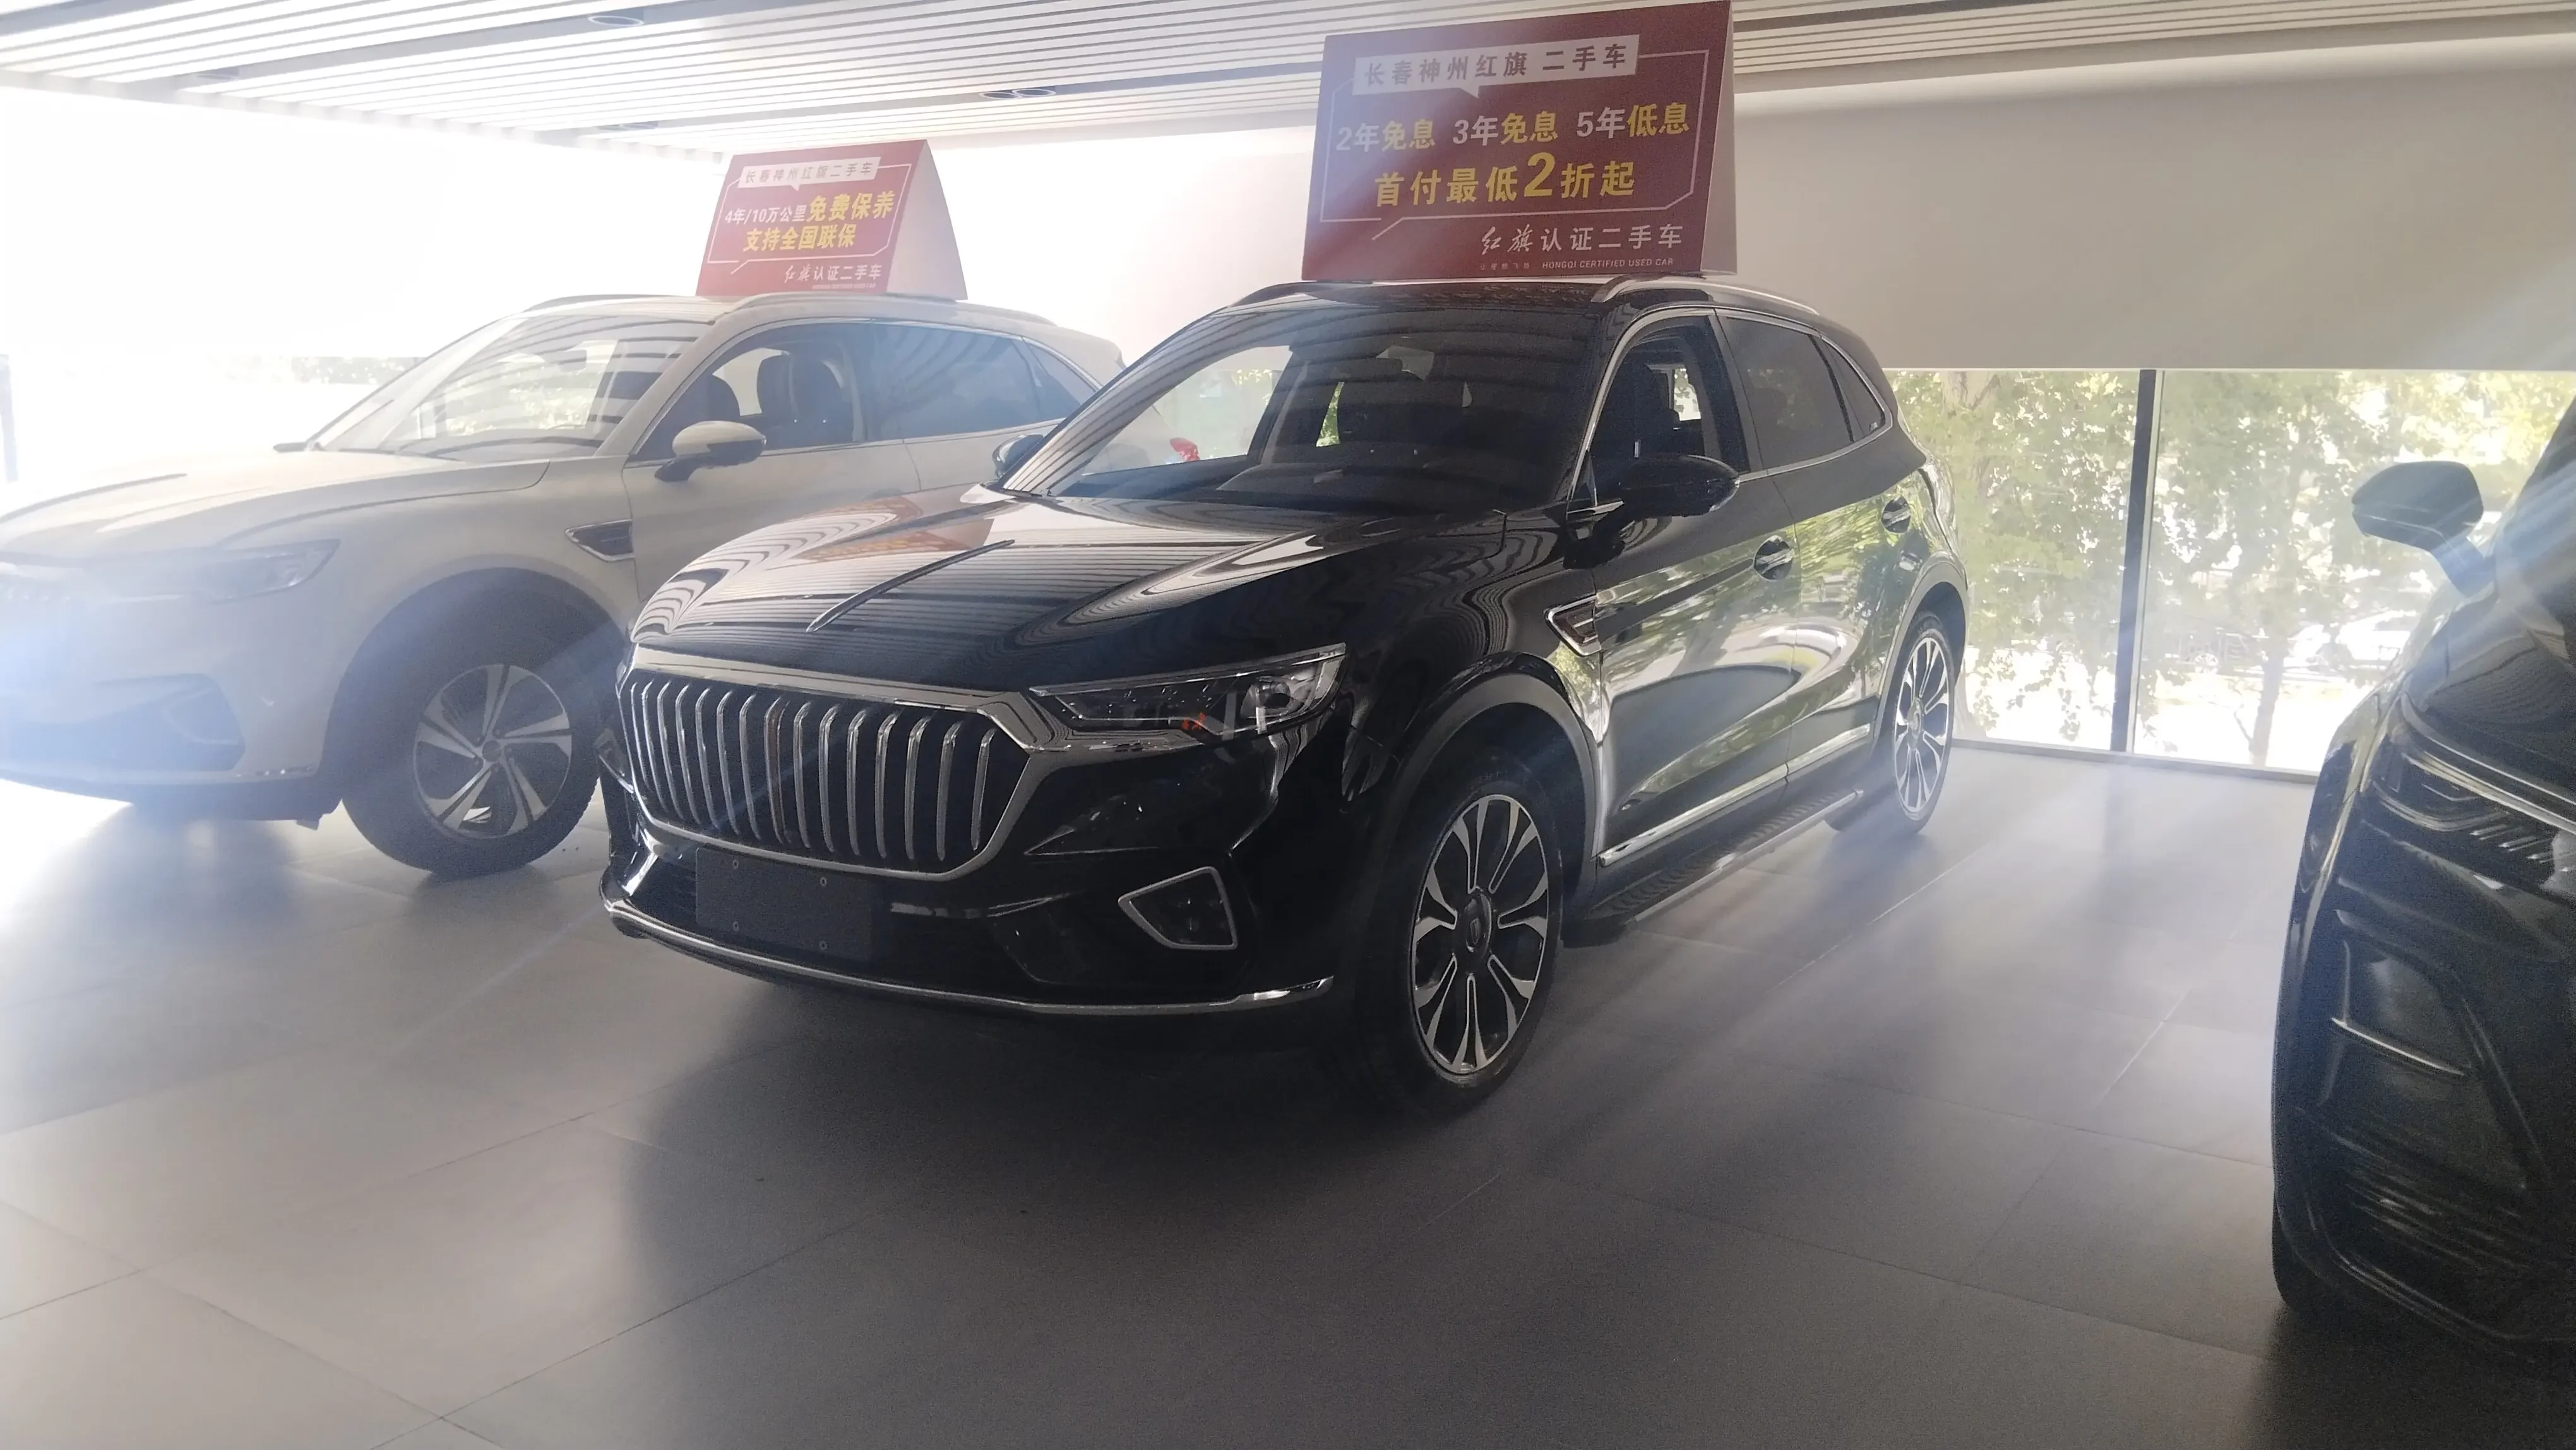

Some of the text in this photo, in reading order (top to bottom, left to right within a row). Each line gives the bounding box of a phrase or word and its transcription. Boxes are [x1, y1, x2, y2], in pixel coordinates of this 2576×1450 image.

[1542, 42, 1627, 71] 二手车
[1335, 101, 1690, 152] 2年免息 3年免息 5年低息
[1374, 152, 1635, 208] 首付最低2折起
[742, 224, 857, 252] 支持全国联保
[1480, 224, 1685, 255] 红旗认证二手车
[783, 263, 883, 283] 红旗认证二手车
[1542, 258, 1674, 269] HONGQI CERTIFIED USED CAR
